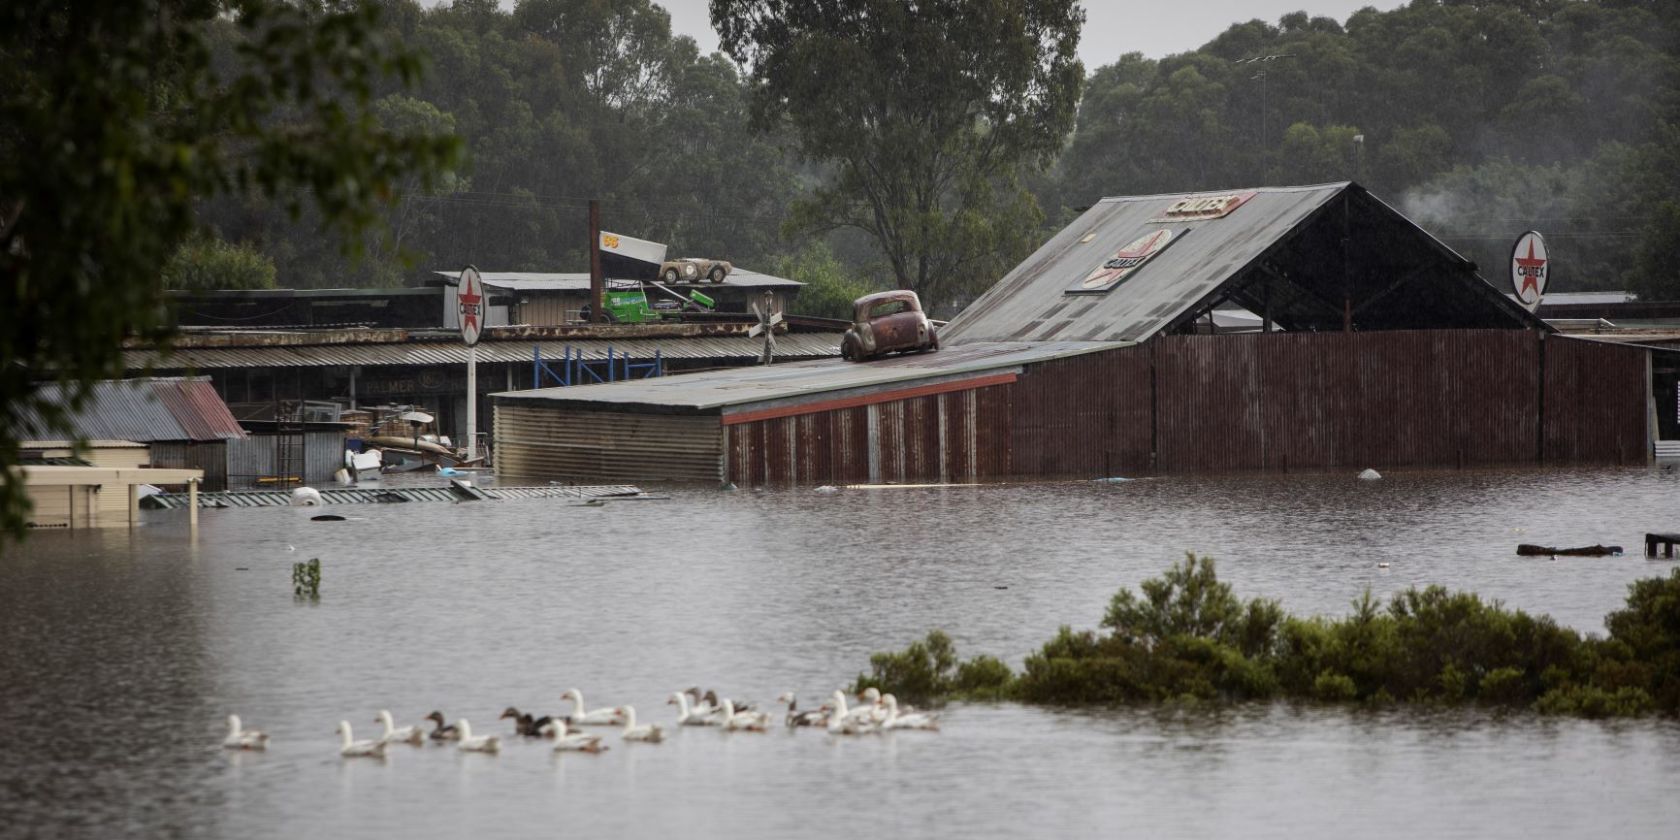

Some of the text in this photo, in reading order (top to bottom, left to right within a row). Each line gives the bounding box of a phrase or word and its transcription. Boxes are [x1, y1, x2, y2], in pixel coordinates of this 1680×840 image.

[1168, 196, 1237, 214] CALTEX
[1517, 265, 1544, 278] CALTEX
[460, 303, 481, 316] CALTEX
